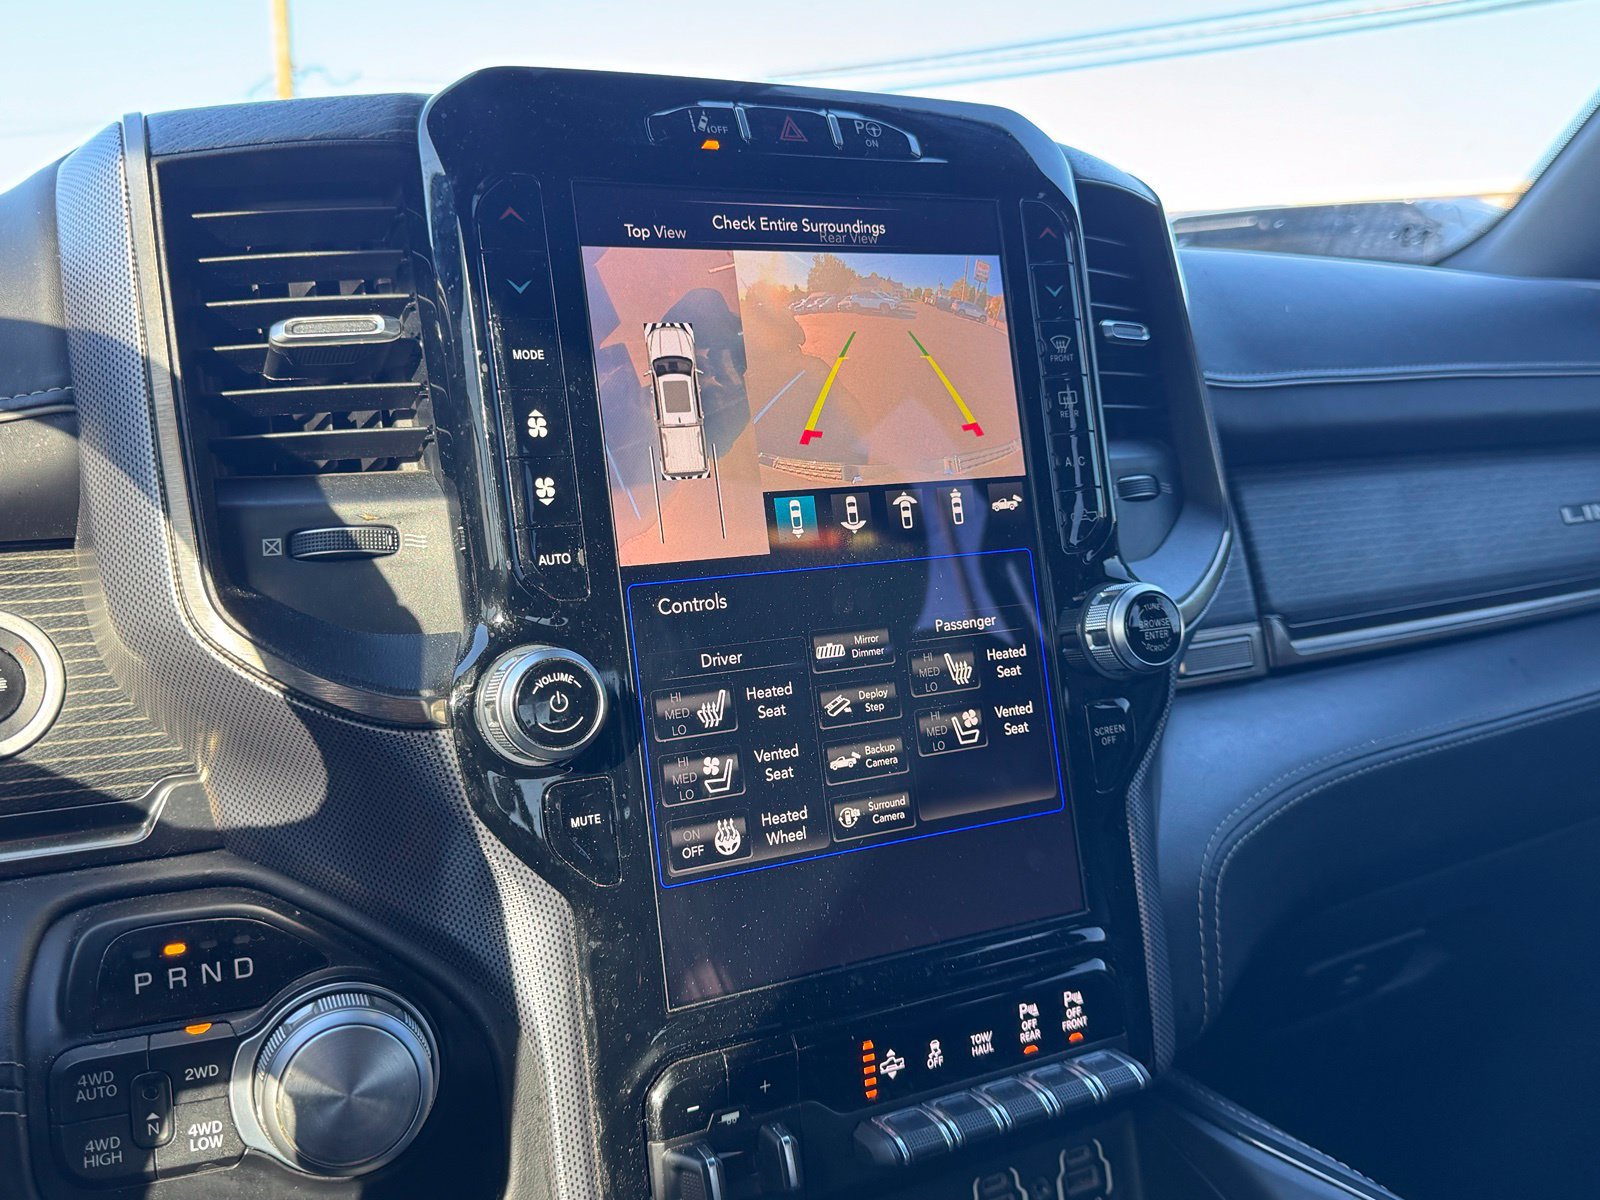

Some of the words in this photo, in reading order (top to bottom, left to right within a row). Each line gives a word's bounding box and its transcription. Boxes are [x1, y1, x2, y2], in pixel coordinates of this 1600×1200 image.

[710, 126, 728, 135] OFF
[865, 139, 879, 148] ON
[624, 223, 650, 240] Top
[654, 225, 686, 239] View
[712, 215, 755, 231] Check
[761, 217, 798, 232] Entire
[802, 218, 886, 236] Surroundings
[820, 230, 846, 243] Rear
[850, 232, 877, 244] View
[512, 349, 545, 360] MODE
[1050, 354, 1073, 362] FRONT
[538, 553, 572, 566] AUTO
[657, 592, 728, 615] Controls
[935, 616, 996, 633] Passenger
[1139, 618, 1170, 628] BROWSE
[854, 635, 879, 645] Mirror
[1145, 630, 1168, 640] ENTER
[851, 647, 884, 659] Dimmer
[986, 644, 1027, 661] Heated
[1146, 642, 1168, 651] SCROLL
[701, 652, 743, 668] Driver
[923, 653, 933, 662] HI
[919, 667, 940, 678] MED
[996, 665, 1022, 678] Seat
[536, 672, 575, 689] VOLUME
[925, 682, 938, 693] LO
[670, 692, 681, 703] HI
[746, 681, 793, 700] Heated
[858, 688, 888, 700] Deploy
[664, 708, 690, 721] MED
[757, 704, 787, 719] Seat
[865, 702, 885, 713] Step
[994, 701, 1033, 718] Vented
[930, 711, 940, 721] HI
[672, 725, 687, 737] LO
[926, 726, 948, 737] MED
[1004, 722, 1029, 736] Seat
[1094, 724, 1125, 736] SCREEN
[933, 741, 945, 752] LO
[1101, 736, 1116, 746] OFF
[754, 743, 799, 763] Vented
[864, 743, 896, 755] Backup
[677, 756, 689, 768] HI
[865, 756, 898, 768] Camera
[672, 772, 698, 786] MED
[765, 766, 794, 782] Seat
[679, 789, 694, 801] LO
[868, 795, 906, 811] Surround
[570, 813, 602, 828] MUTE
[761, 805, 808, 827] Heated
[872, 811, 905, 824] Camera
[683, 830, 700, 841] ON
[766, 826, 807, 846] Wheel
[682, 844, 705, 859] OFF
[134, 973, 152, 994] P
[168, 967, 187, 989] R
[201, 961, 222, 984] N
[234, 957, 254, 979] D
[1066, 1006, 1082, 1019] OFF
[1021, 1018, 1037, 1031] OFF
[1062, 1015, 1088, 1032] FRONT
[970, 1030, 993, 1046] TOW/
[1019, 1029, 1041, 1044] REAR
[971, 1043, 995, 1057] HAUL
[927, 1056, 943, 1070] OFF
[77, 1071, 114, 1087] 4WD
[185, 1065, 219, 1081] 2WD
[76, 1085, 117, 1103] AUTO
[147, 1122, 159, 1136] N
[188, 1120, 223, 1137] 4WD
[85, 1137, 120, 1152] 4WD
[189, 1135, 223, 1152] LOW
[84, 1151, 123, 1168] HIGH
